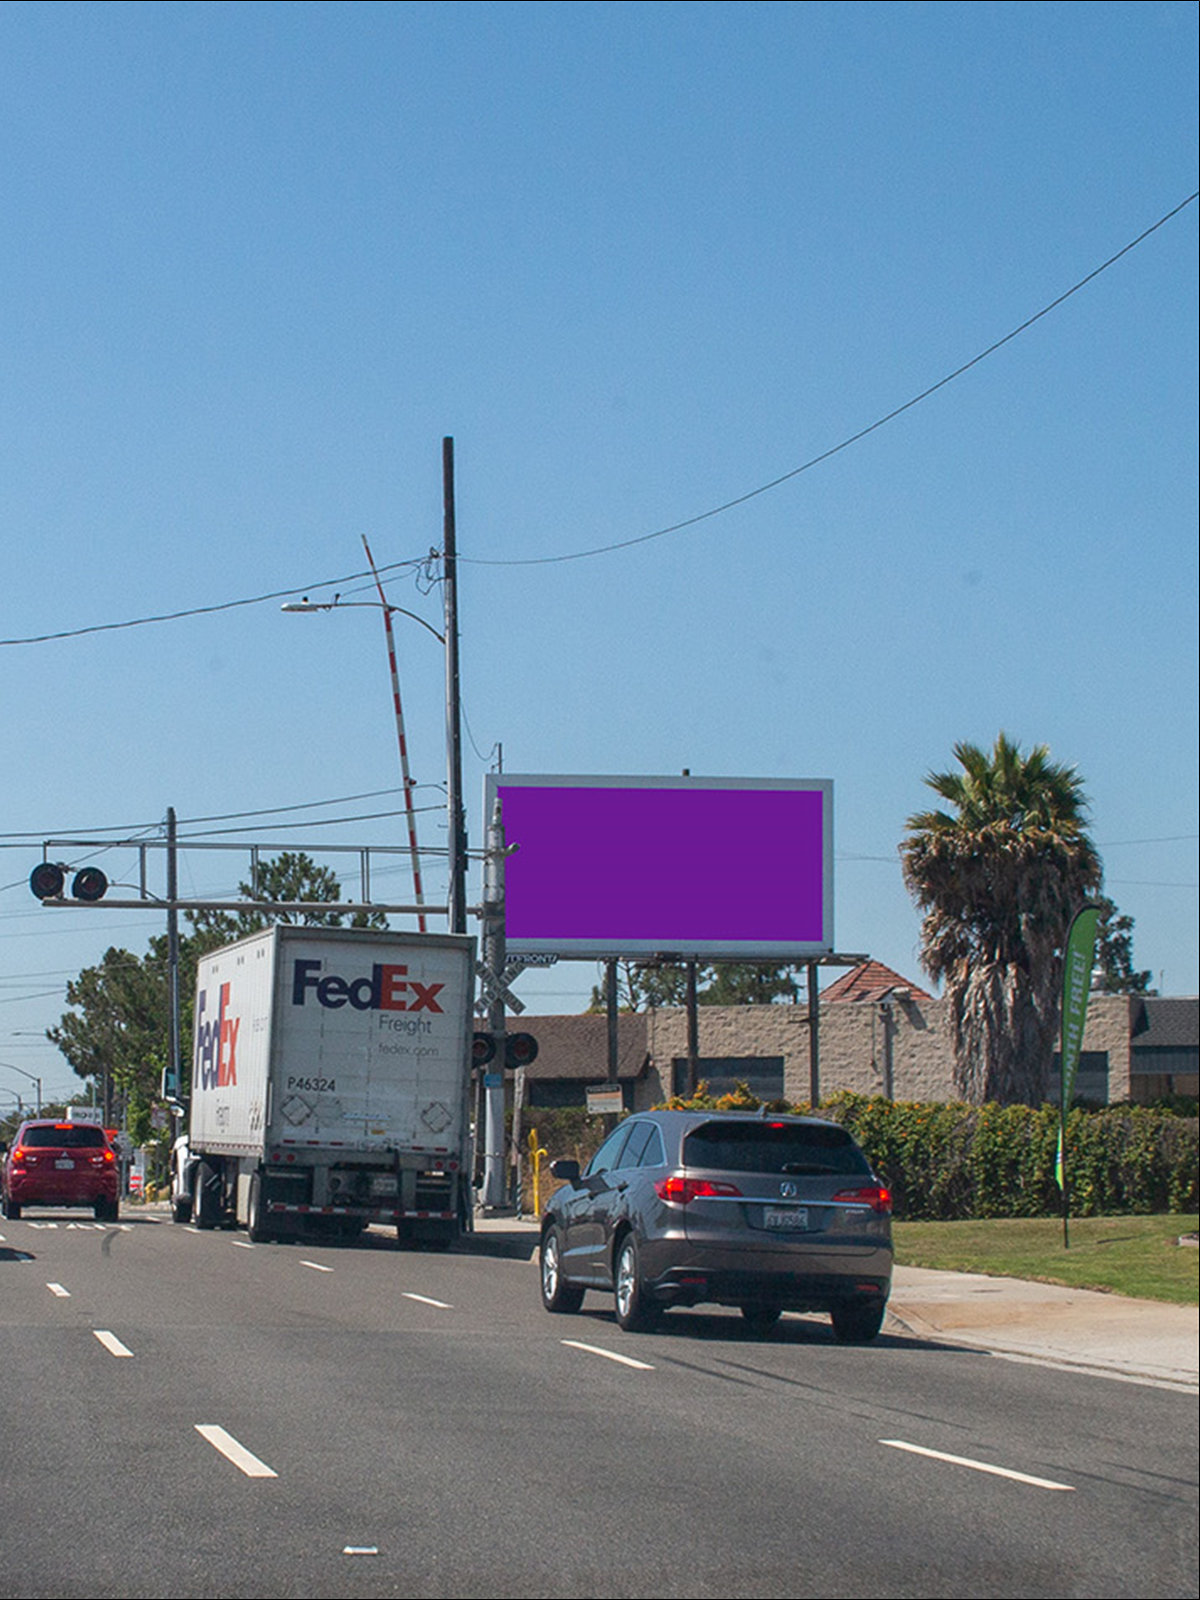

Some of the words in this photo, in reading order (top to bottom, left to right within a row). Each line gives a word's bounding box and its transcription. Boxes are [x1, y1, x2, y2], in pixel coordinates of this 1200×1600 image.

[292, 958, 445, 1014] FedEx
[1069, 950, 1087, 1015] FREE!
[195, 982, 240, 1091] FedEx
[379, 1015, 432, 1036] Freight
[379, 1043, 439, 1056] fedex.com
[287, 1076, 336, 1092] P46324
